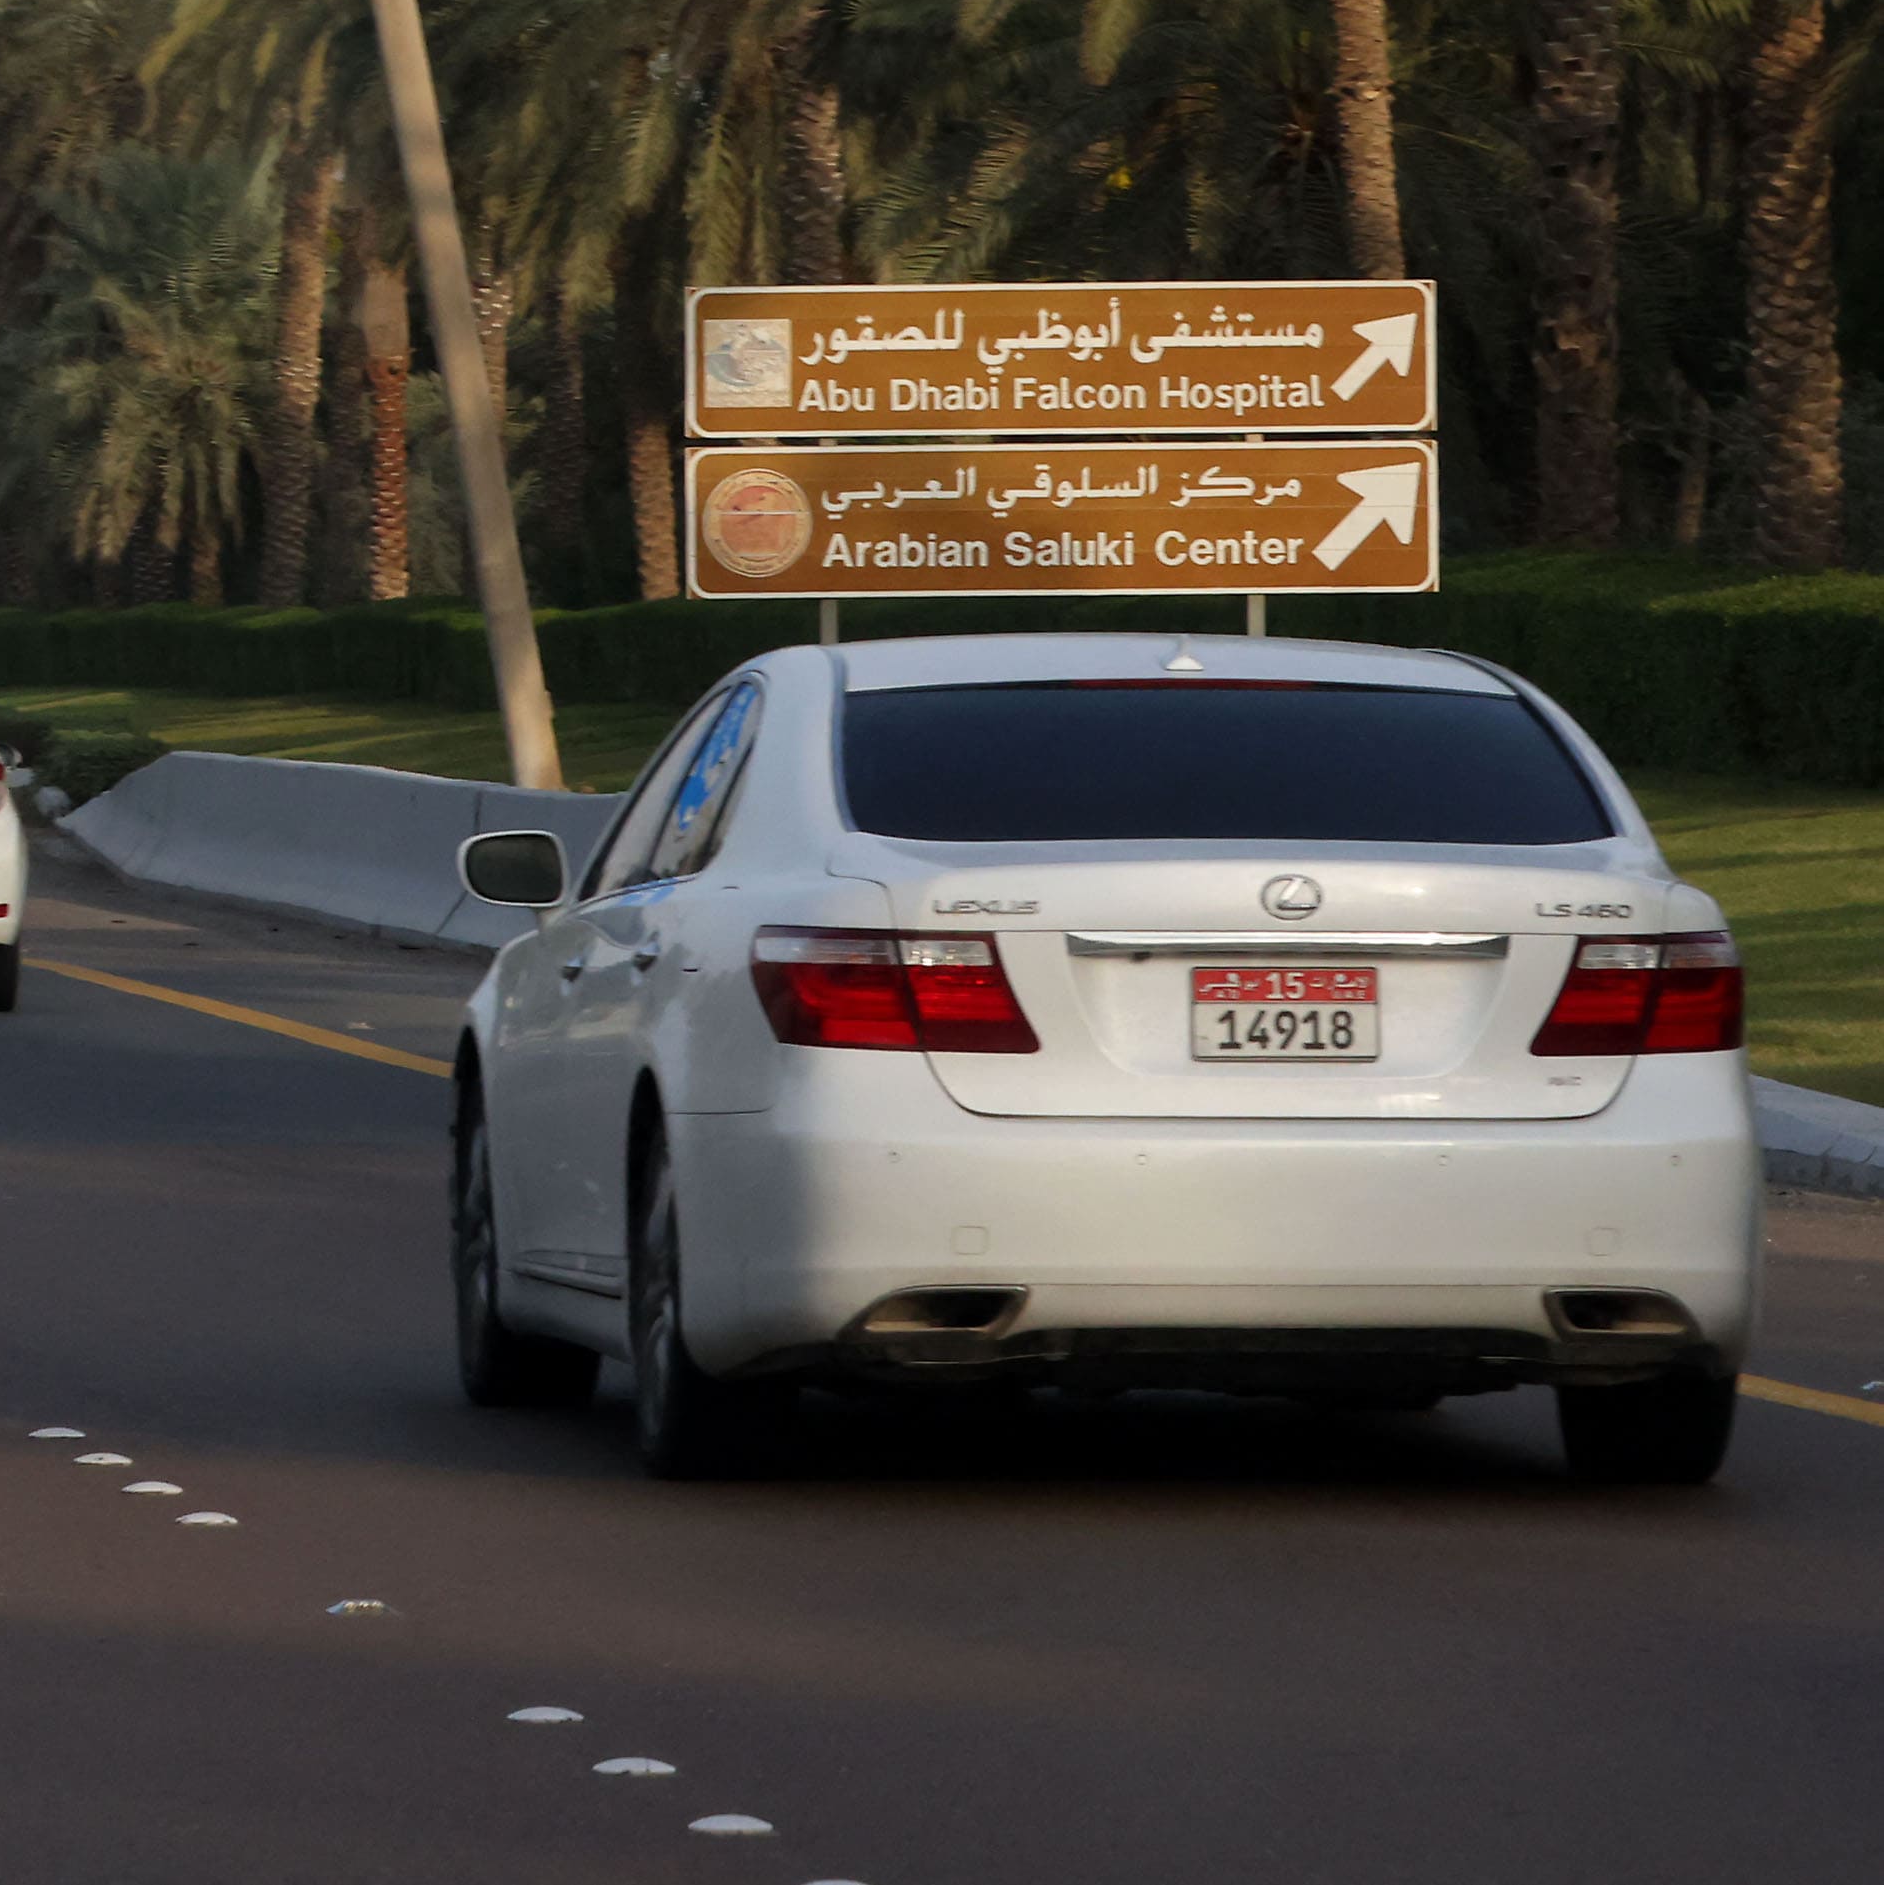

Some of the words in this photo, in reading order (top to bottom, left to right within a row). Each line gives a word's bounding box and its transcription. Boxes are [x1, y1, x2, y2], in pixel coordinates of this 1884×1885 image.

[798, 309, 965, 366] للصقور
[1130, 305, 1324, 364] مستشفى
[798, 379, 875, 412] Abu
[890, 376, 999, 412] Dhabi
[1013, 376, 1147, 410] Falcon
[1159, 374, 1325, 416] Hospital
[821, 466, 977, 519] العربي
[986, 464, 1159, 518] السلوقي
[1169, 466, 1302, 508] مركز
[822, 533, 990, 568] Arabian
[1004, 531, 1134, 567] Saluki
[1154, 530, 1305, 566] Center
[1535, 902, 1573, 917] LS
[1264, 971, 1307, 1000] 15
[1217, 1009, 1354, 1051] 14918
